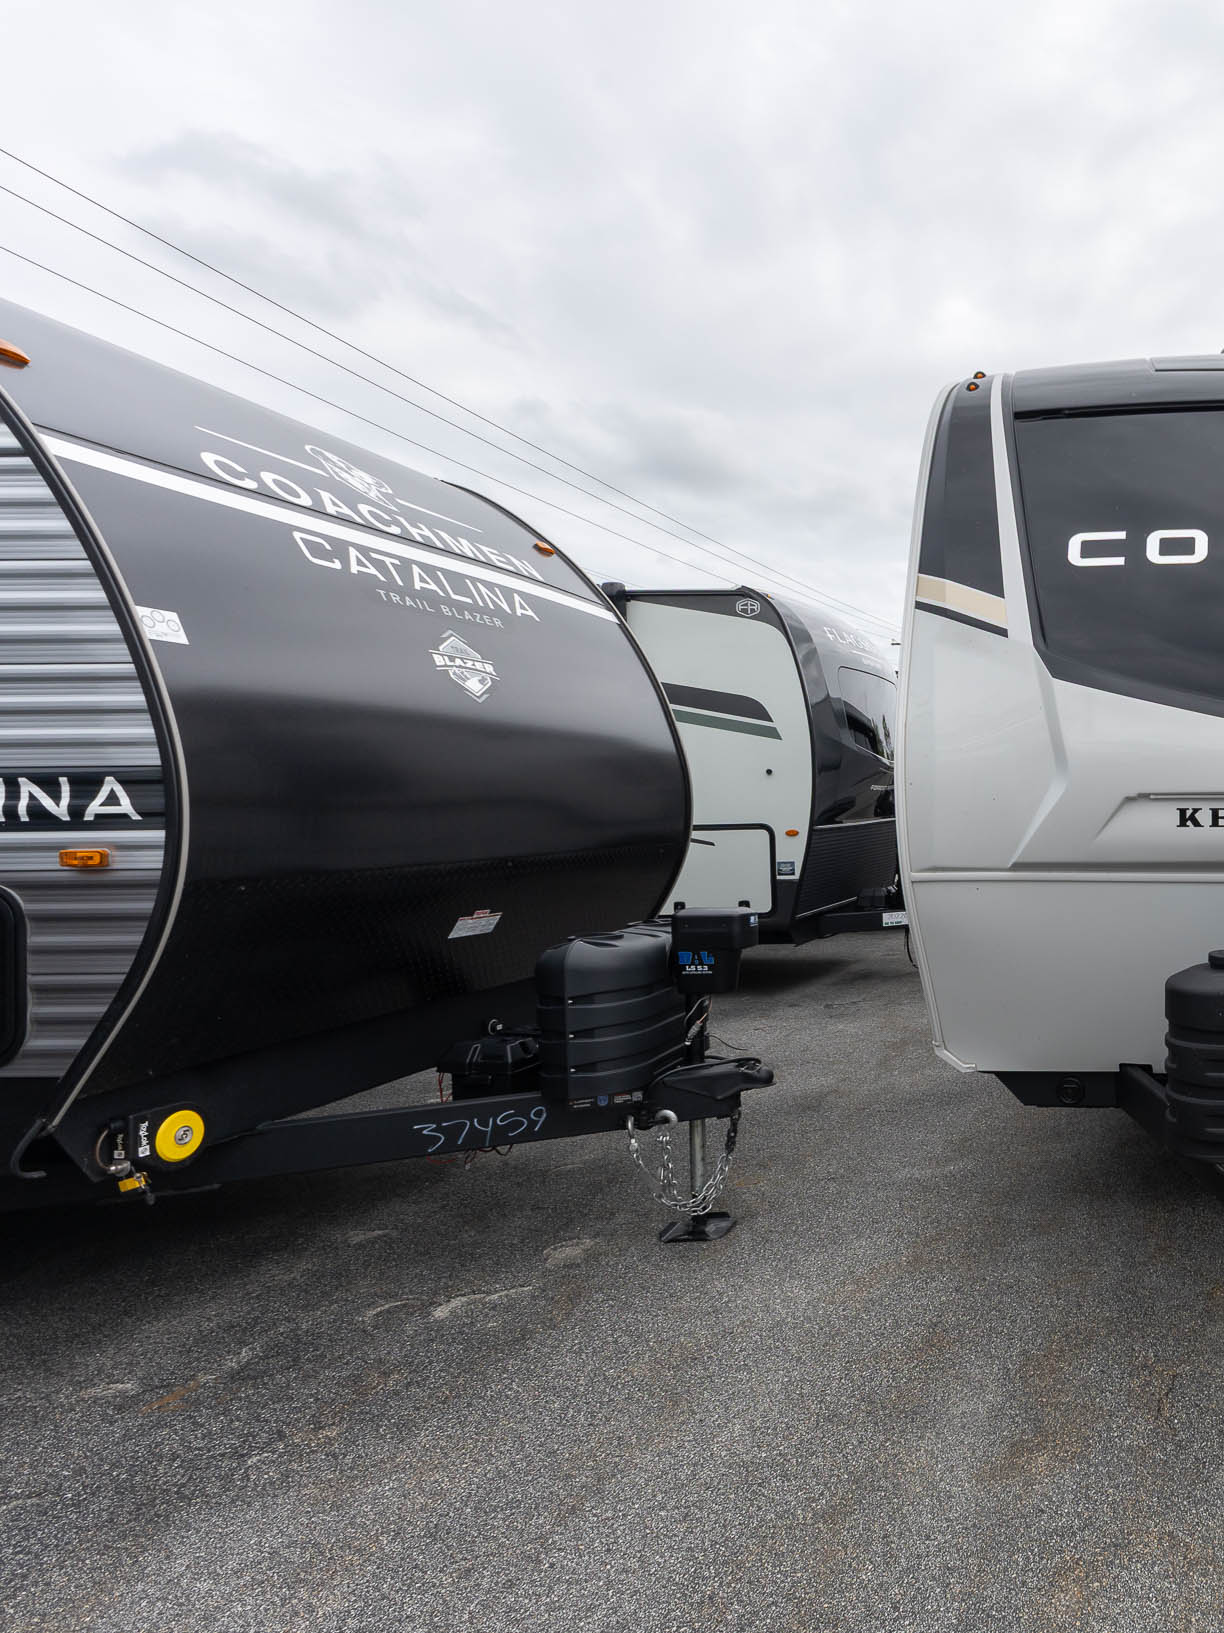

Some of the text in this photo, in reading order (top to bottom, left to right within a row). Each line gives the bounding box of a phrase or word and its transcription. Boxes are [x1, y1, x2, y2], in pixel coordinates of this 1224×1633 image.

[200, 451, 545, 581] COACHMEN
[292, 530, 541, 622] CATALINA
[376, 588, 505, 629] TRAIL BLAZER
[431, 653, 498, 677] BLAZER
[413, 1105, 547, 1153] 37459
